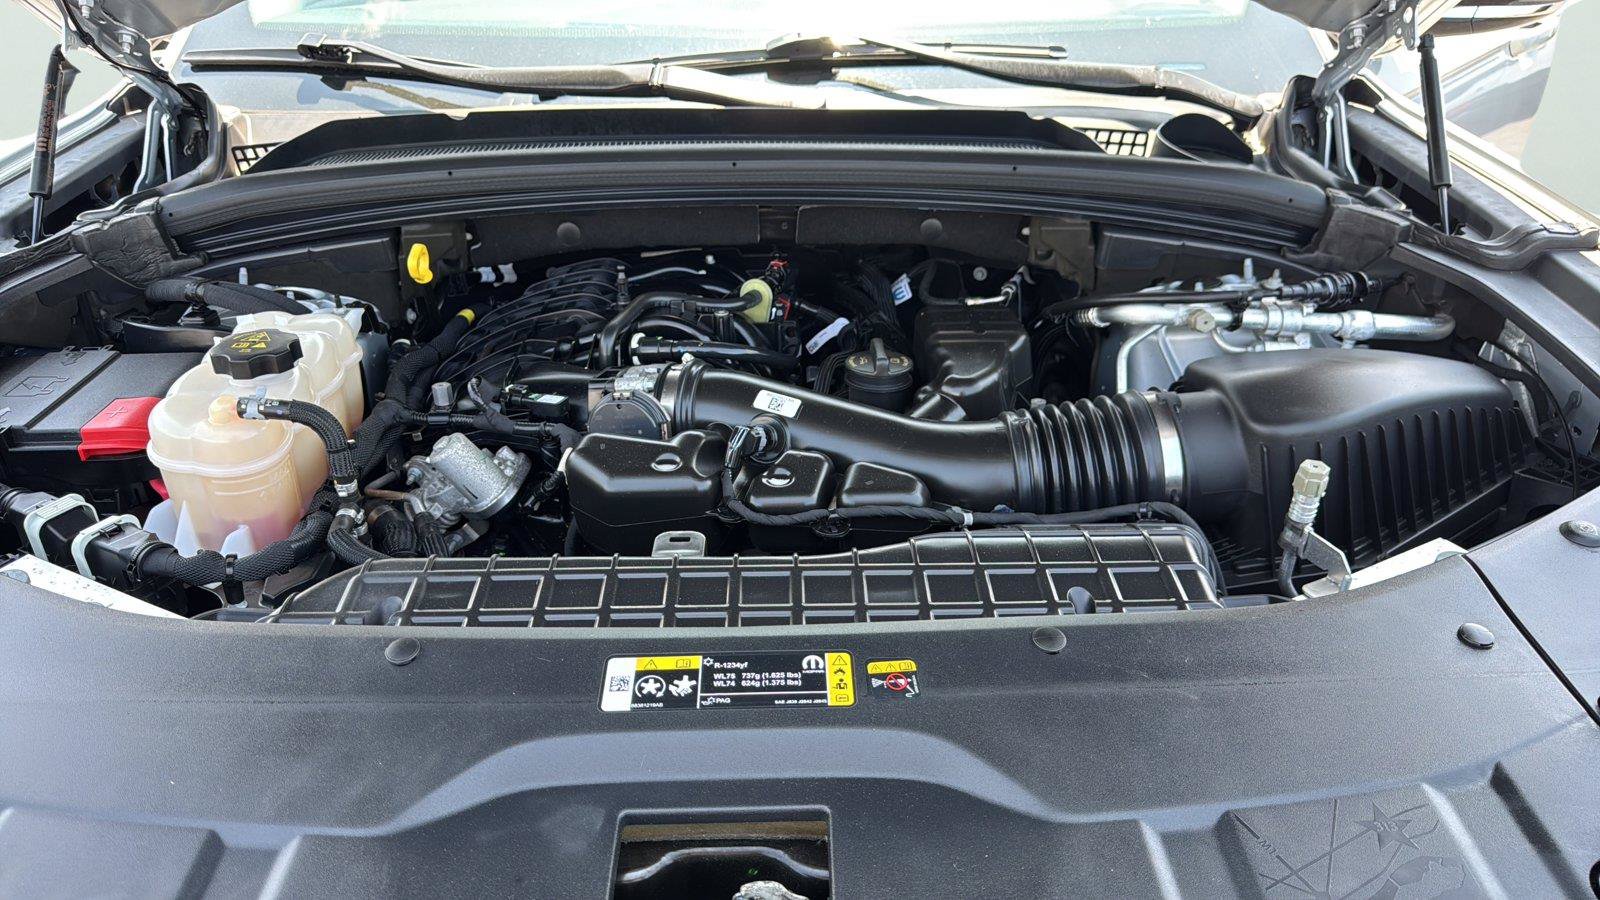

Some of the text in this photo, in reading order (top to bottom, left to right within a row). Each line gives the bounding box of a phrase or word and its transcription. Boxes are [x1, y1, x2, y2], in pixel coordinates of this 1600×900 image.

[714, 661, 749, 670] R-1234yf
[762, 672, 786, 680] (1.625
[741, 680, 760, 688] 624g
[762, 679, 786, 688] (1.375
[786, 679, 802, 687] lbs)
